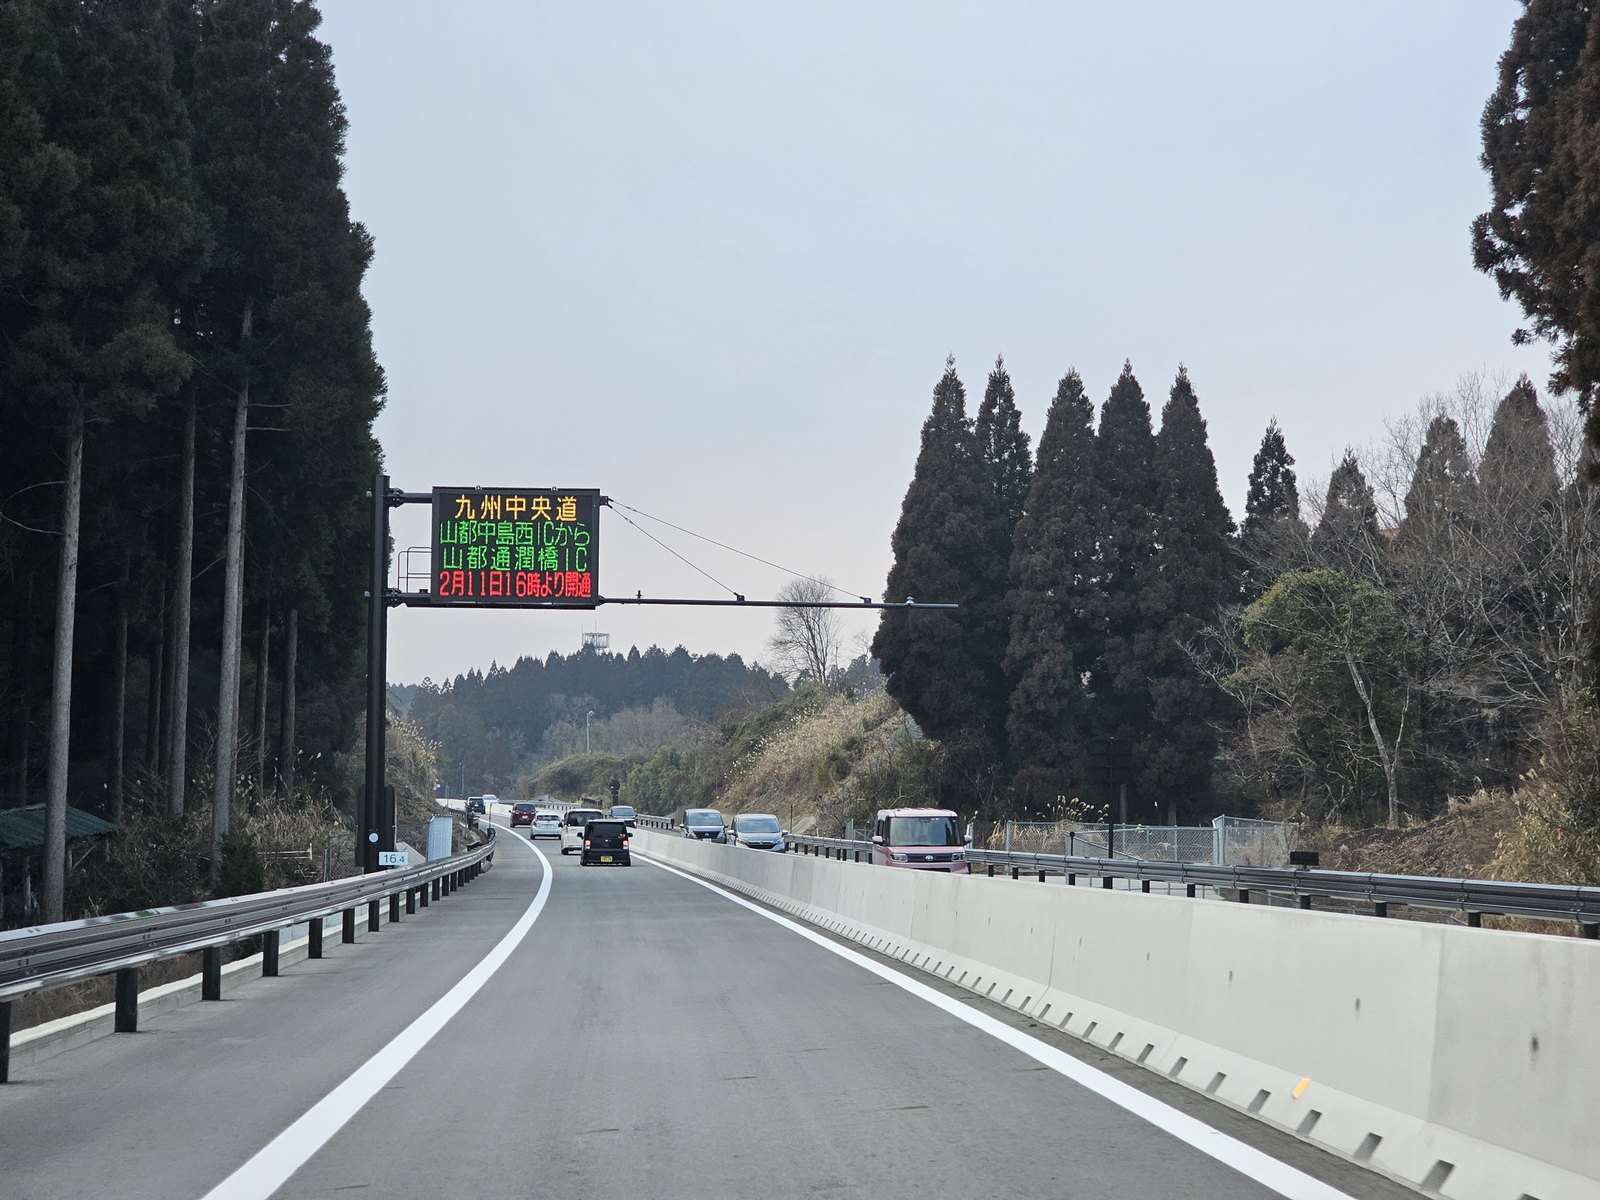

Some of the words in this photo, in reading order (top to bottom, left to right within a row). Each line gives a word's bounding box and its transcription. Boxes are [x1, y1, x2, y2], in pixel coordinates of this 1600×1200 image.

[455, 494, 577, 521] 九州中央道
[440, 520, 590, 546] 山都中島西ICから
[443, 546, 587, 572] 山都通潤橋IC
[439, 570, 592, 598] 2月11日16時より開通
[383, 853, 405, 863] 16.4
